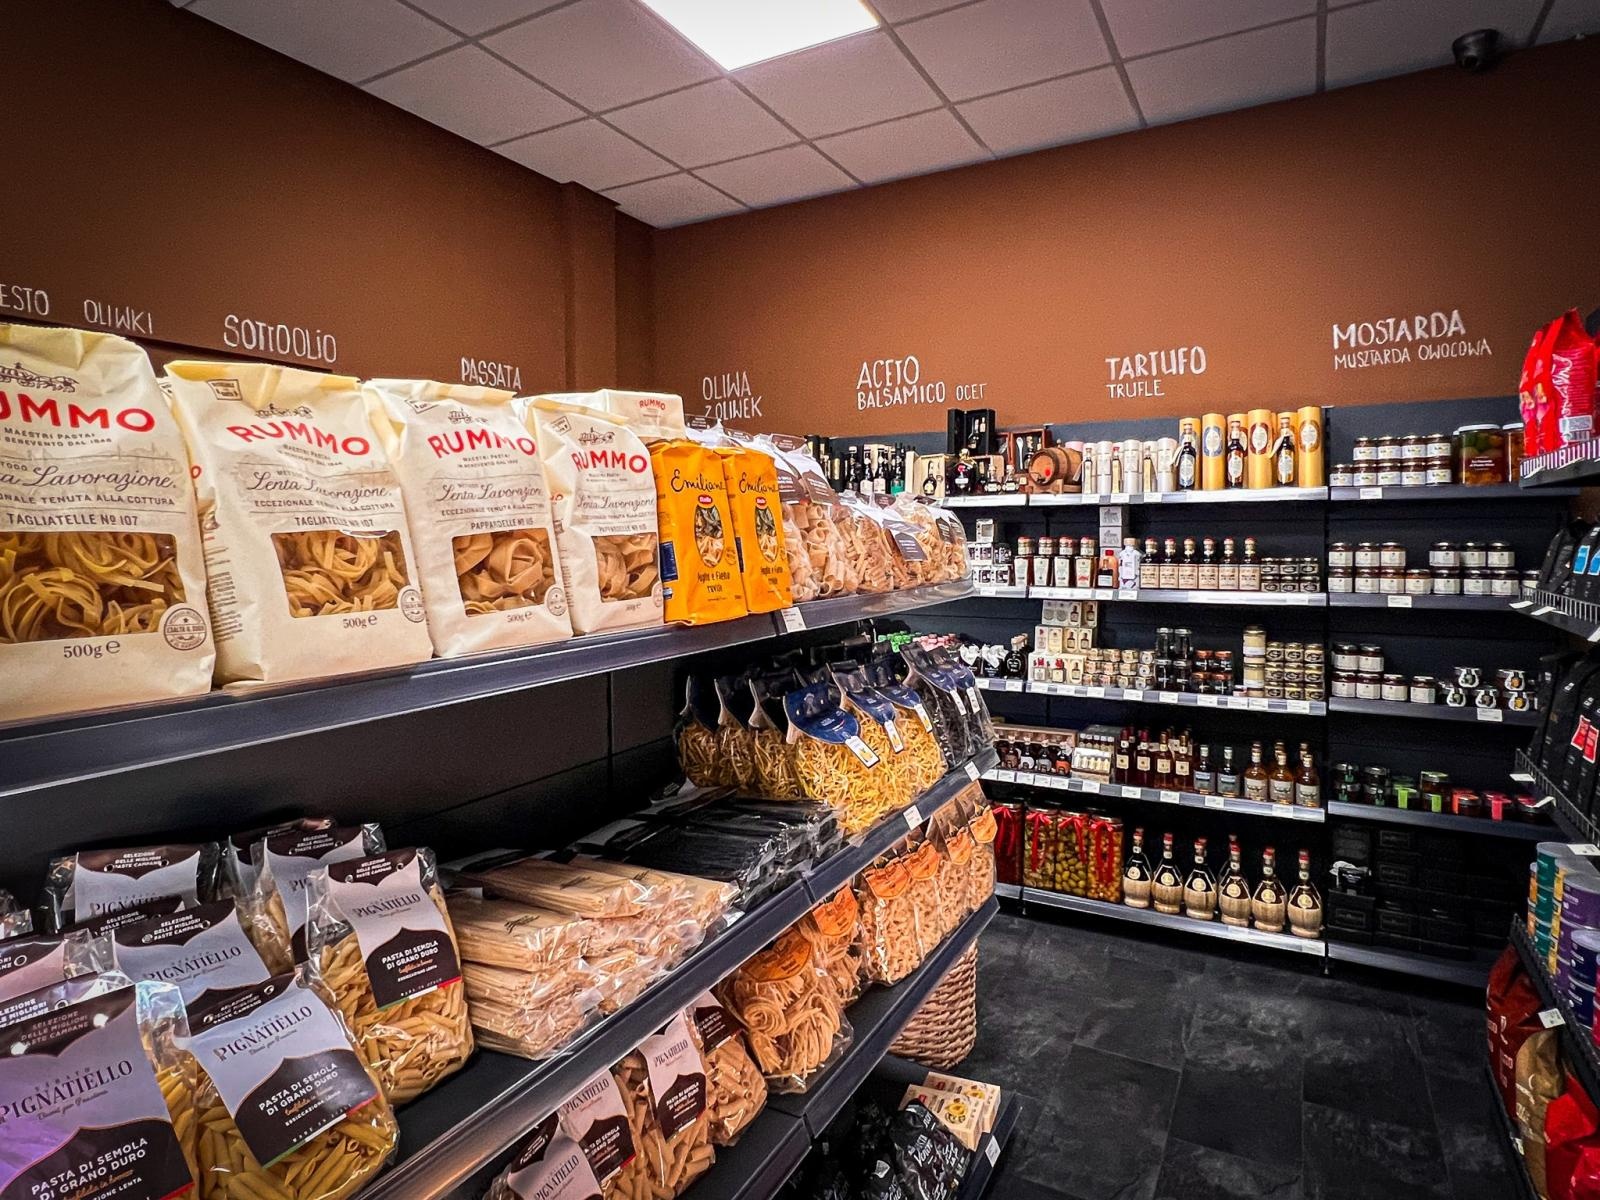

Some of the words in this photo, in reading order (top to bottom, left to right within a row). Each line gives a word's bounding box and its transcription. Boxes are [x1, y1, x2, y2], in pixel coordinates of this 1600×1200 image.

[84, 299, 153, 334] OLIWKI
[1332, 309, 1466, 349] MOSTARDA
[1105, 346, 1207, 381] TARTUFO
[1334, 347, 1411, 371] MUSZTARDA
[1417, 338, 1493, 361] OWOCOWA
[460, 357, 522, 390] PASSATA
[856, 355, 920, 390] ACETO
[702, 371, 752, 400] OLIWA
[857, 381, 946, 411] BALSAMICO
[956, 383, 988, 401] OCET
[1105, 380, 1165, 399] TRUFLE
[639, 399, 666, 411] RUMMO
[715, 396, 762, 420] OLIWEK
[226, 420, 371, 456] RUMMO
[427, 429, 536, 458] RUMMO
[571, 450, 647, 473] RUMMO
[246, 471, 302, 491] Lenta
[41, 493, 92, 504] TENUTA
[96, 493, 125, 503] ALLA
[127, 495, 175, 506] COTTURA
[254, 499, 314, 507] ECCEZIONALE
[6, 512, 97, 526] TAGLIATELLE
[120, 515, 139, 526] 107
[63, 644, 103, 659] 500g
[353, 893, 421, 918] PIGNATIELLO
[153, 925, 173, 935] DELLE
[160, 914, 194, 928] SELEZIONE
[144, 945, 242, 982] PIGNATIELLO
[382, 950, 404, 964] PASTA
[404, 948, 413, 956] DI
[413, 940, 439, 953] SEMOLA
[386, 961, 396, 970] DI
[395, 953, 420, 966] GRANO
[420, 947, 439, 958] DURO
[9, 1001, 47, 1019] MIGLIORI
[32, 1011, 79, 1030] SELEZIONE
[21, 1028, 48, 1041] DELLE
[50, 1015, 88, 1031] MIGLIORI
[49, 1022, 89, 1039] CAMPANE
[213, 1006, 312, 1062] PIGNATIELLO
[258, 1089, 290, 1111] PASTA
[291, 1083, 302, 1093] DI
[302, 1062, 338, 1086] SEMOLA
[266, 1106, 279, 1116] DI
[280, 1085, 313, 1108] GRANO
[314, 1071, 339, 1087] DURO
[565, 1078, 610, 1114] PIGNATIELLO
[31, 1166, 76, 1195] PASTA
[79, 1160, 94, 1174] DI
[97, 1137, 148, 1165] SEMOLA
[39, 1188, 56, 1200] DI
[59, 1167, 107, 1194] GRANO
[111, 1149, 146, 1171] DURO
[118, 1176, 143, 1192] LENTA
